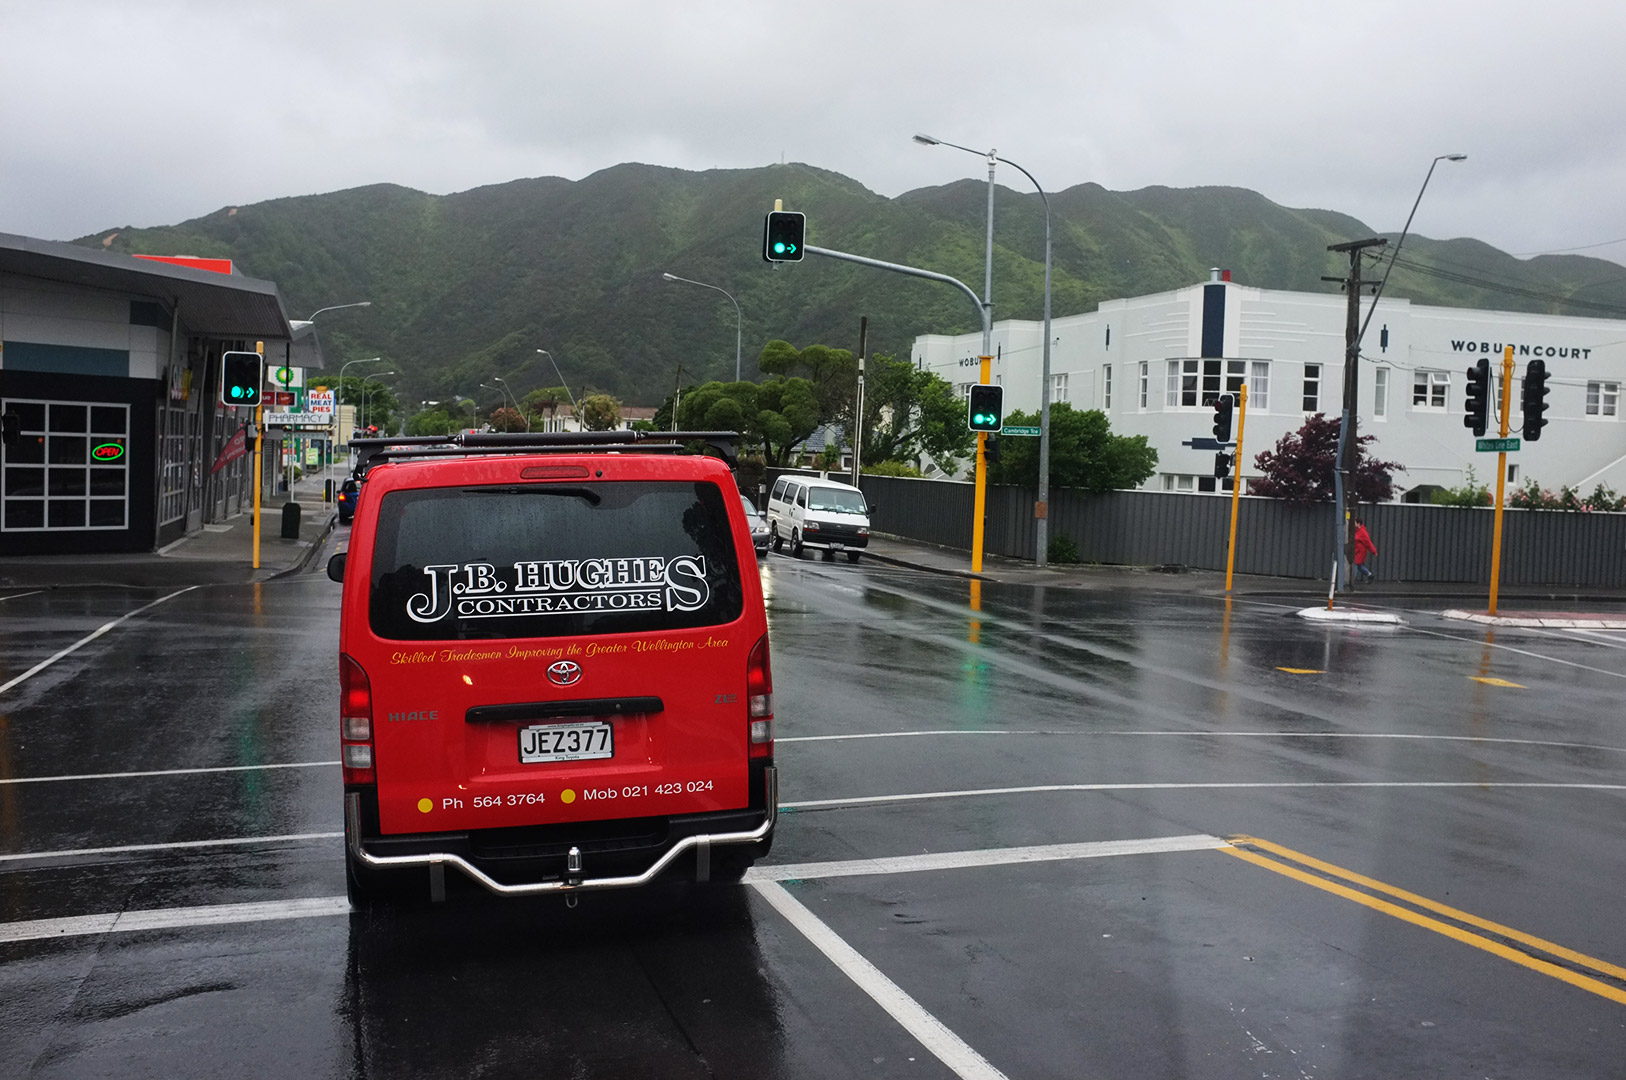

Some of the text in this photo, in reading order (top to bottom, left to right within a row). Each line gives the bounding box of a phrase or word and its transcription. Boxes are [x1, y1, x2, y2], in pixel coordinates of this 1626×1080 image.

[959, 357, 981, 367] WOBU
[268, 414, 322, 422] PHARMACY
[96, 447, 120, 456] OPEN
[1506, 440, 1518, 448] East
[406, 555, 710, 623] J.B. HUGHES
[457, 593, 662, 615] CONTRACTORS
[389, 636, 728, 665] Skilled Tradesmen Improving the Greater Wellington Area
[388, 710, 439, 722] HIACE
[524, 728, 609, 754] JEZ377
[584, 780, 714, 800] Mob 021 423 024
[442, 793, 546, 810] Ph 564 3764
